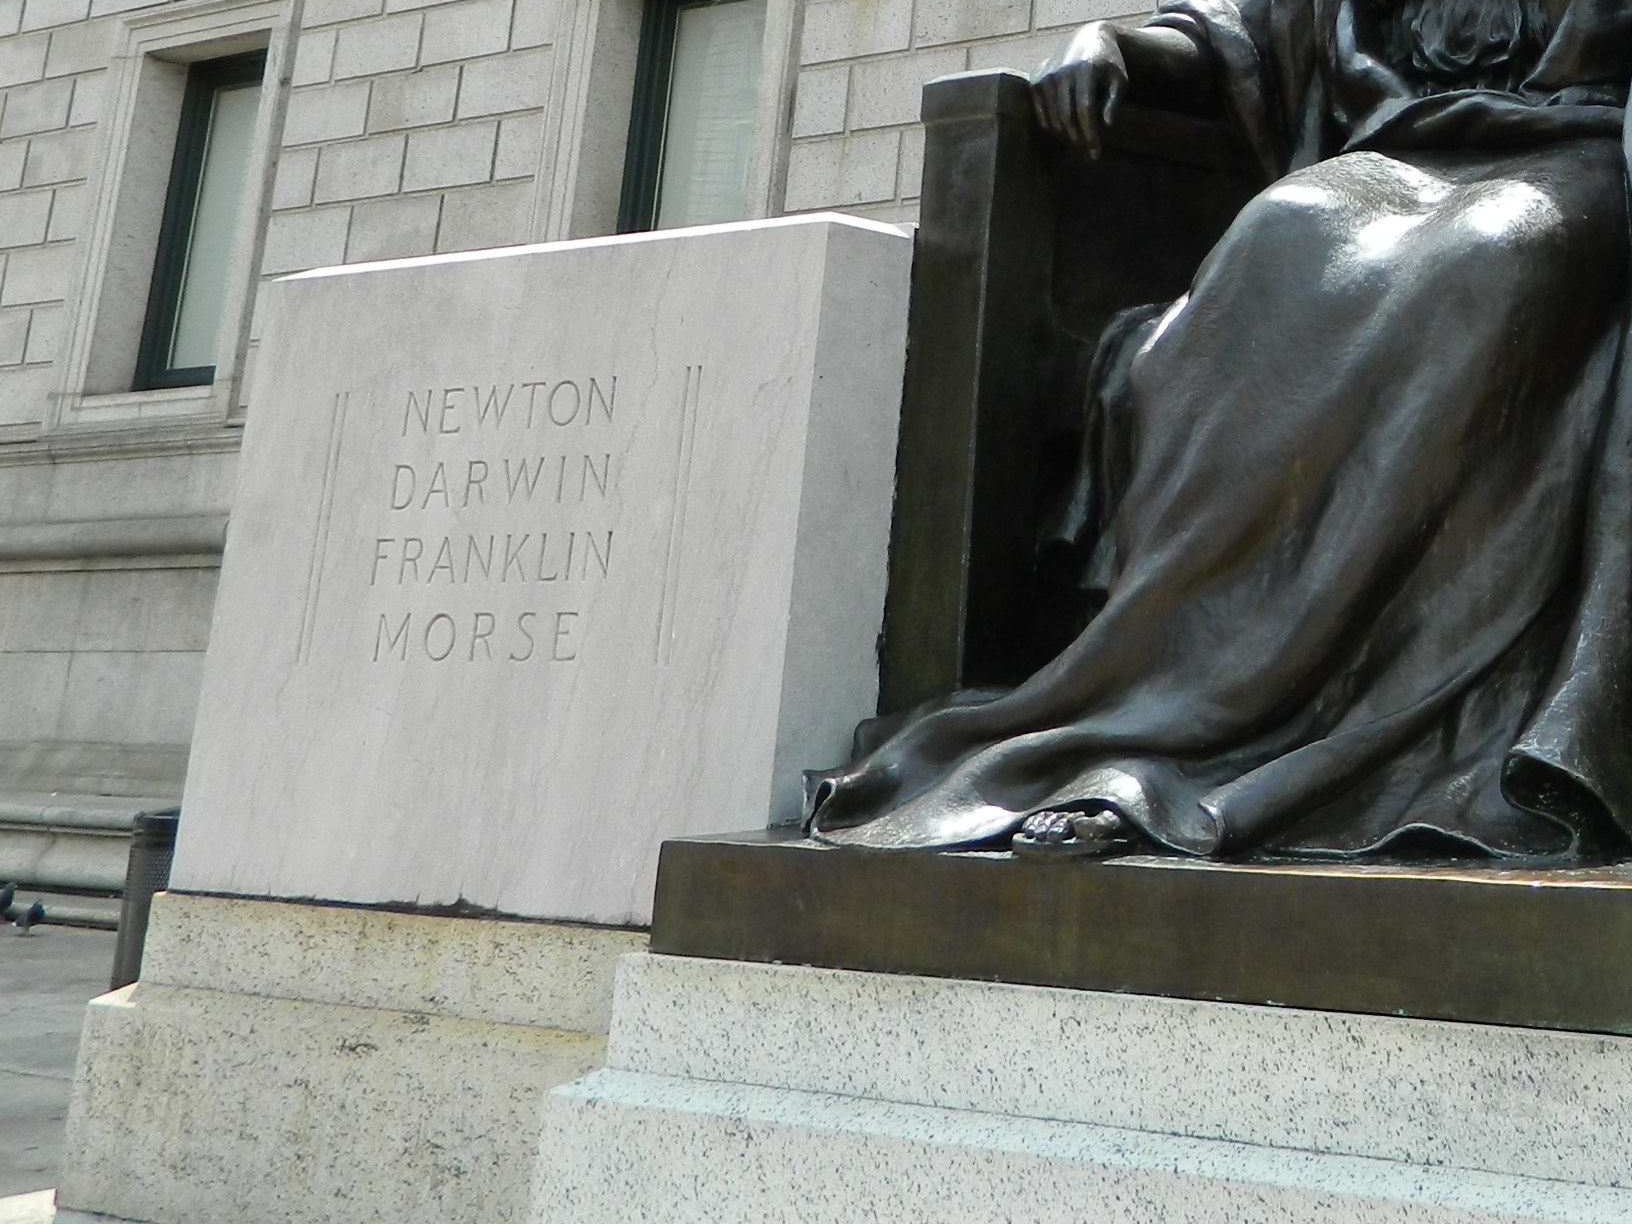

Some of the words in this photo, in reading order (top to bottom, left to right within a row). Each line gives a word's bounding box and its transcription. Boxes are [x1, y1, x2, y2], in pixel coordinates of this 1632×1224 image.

[401, 376, 618, 437] NEWTON
[391, 453, 611, 511] DARWIN
[370, 530, 614, 586] FRANKLIN
[372, 612, 579, 662] MORSE
